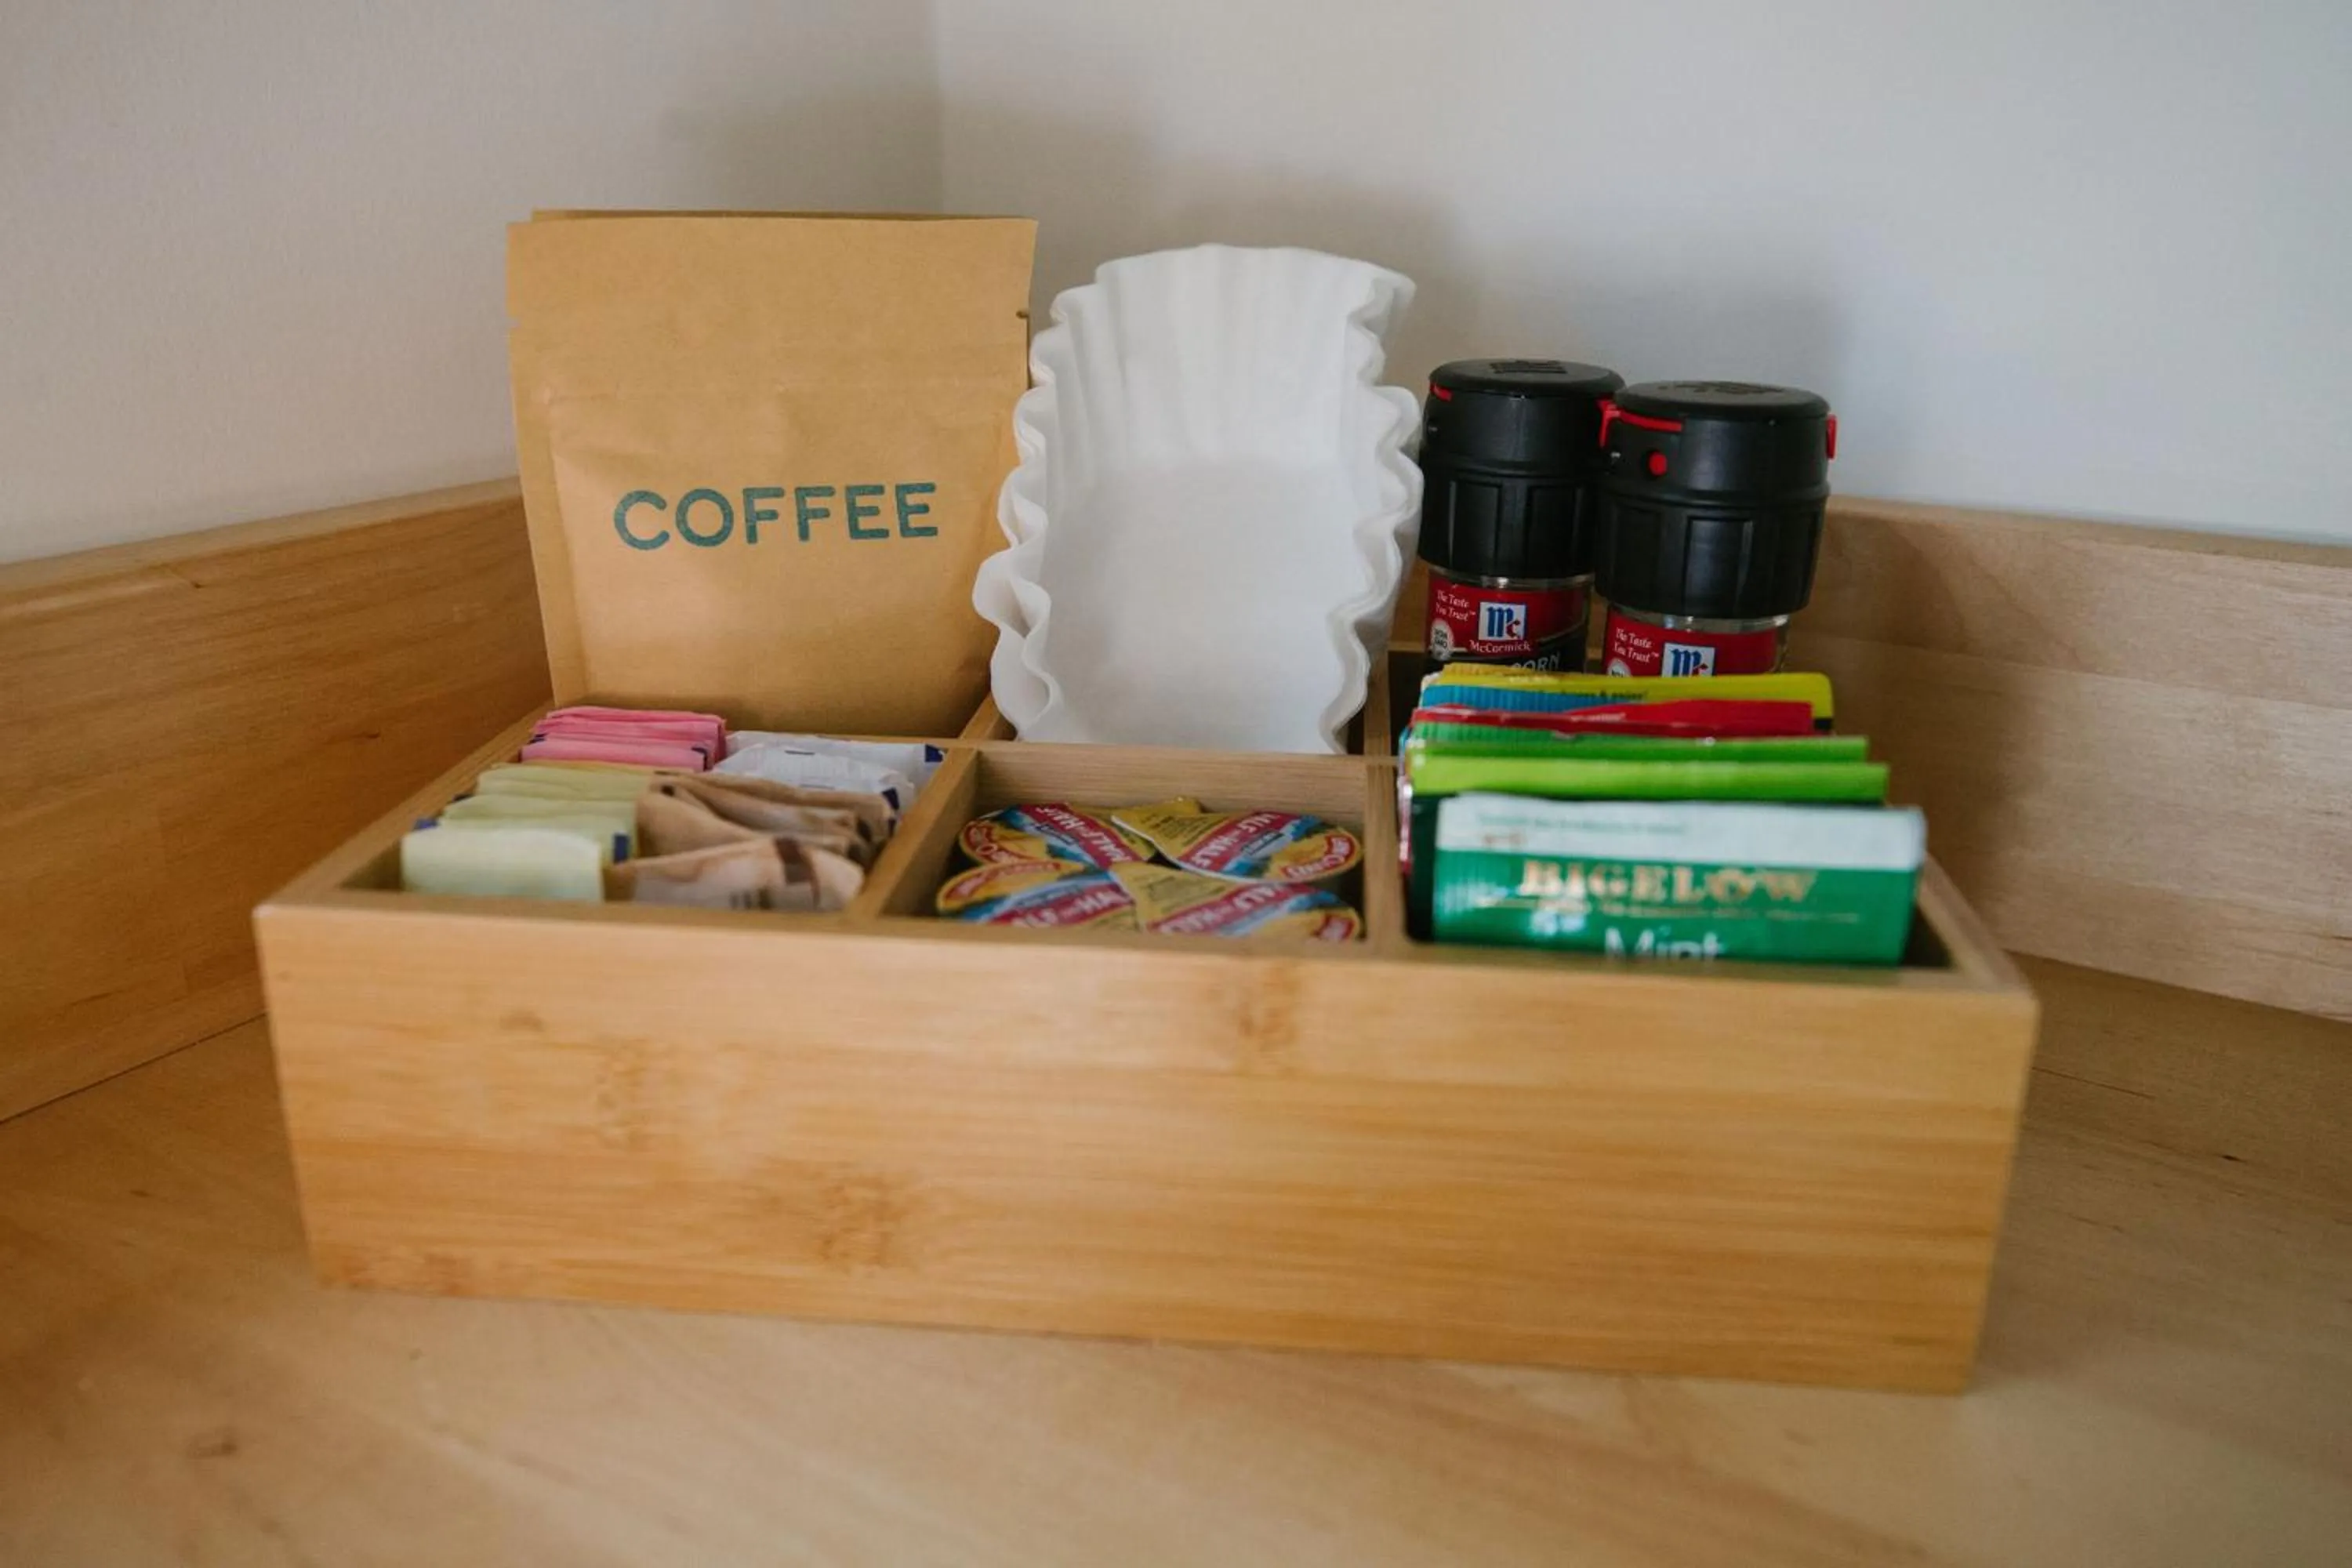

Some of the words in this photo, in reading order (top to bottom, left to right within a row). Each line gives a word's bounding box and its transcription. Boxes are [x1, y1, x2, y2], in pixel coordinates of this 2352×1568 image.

[614, 482, 938, 550] COFFEE
[1469, 639, 1532, 653] McCormick
[1519, 859, 1817, 902] BIGELOW
